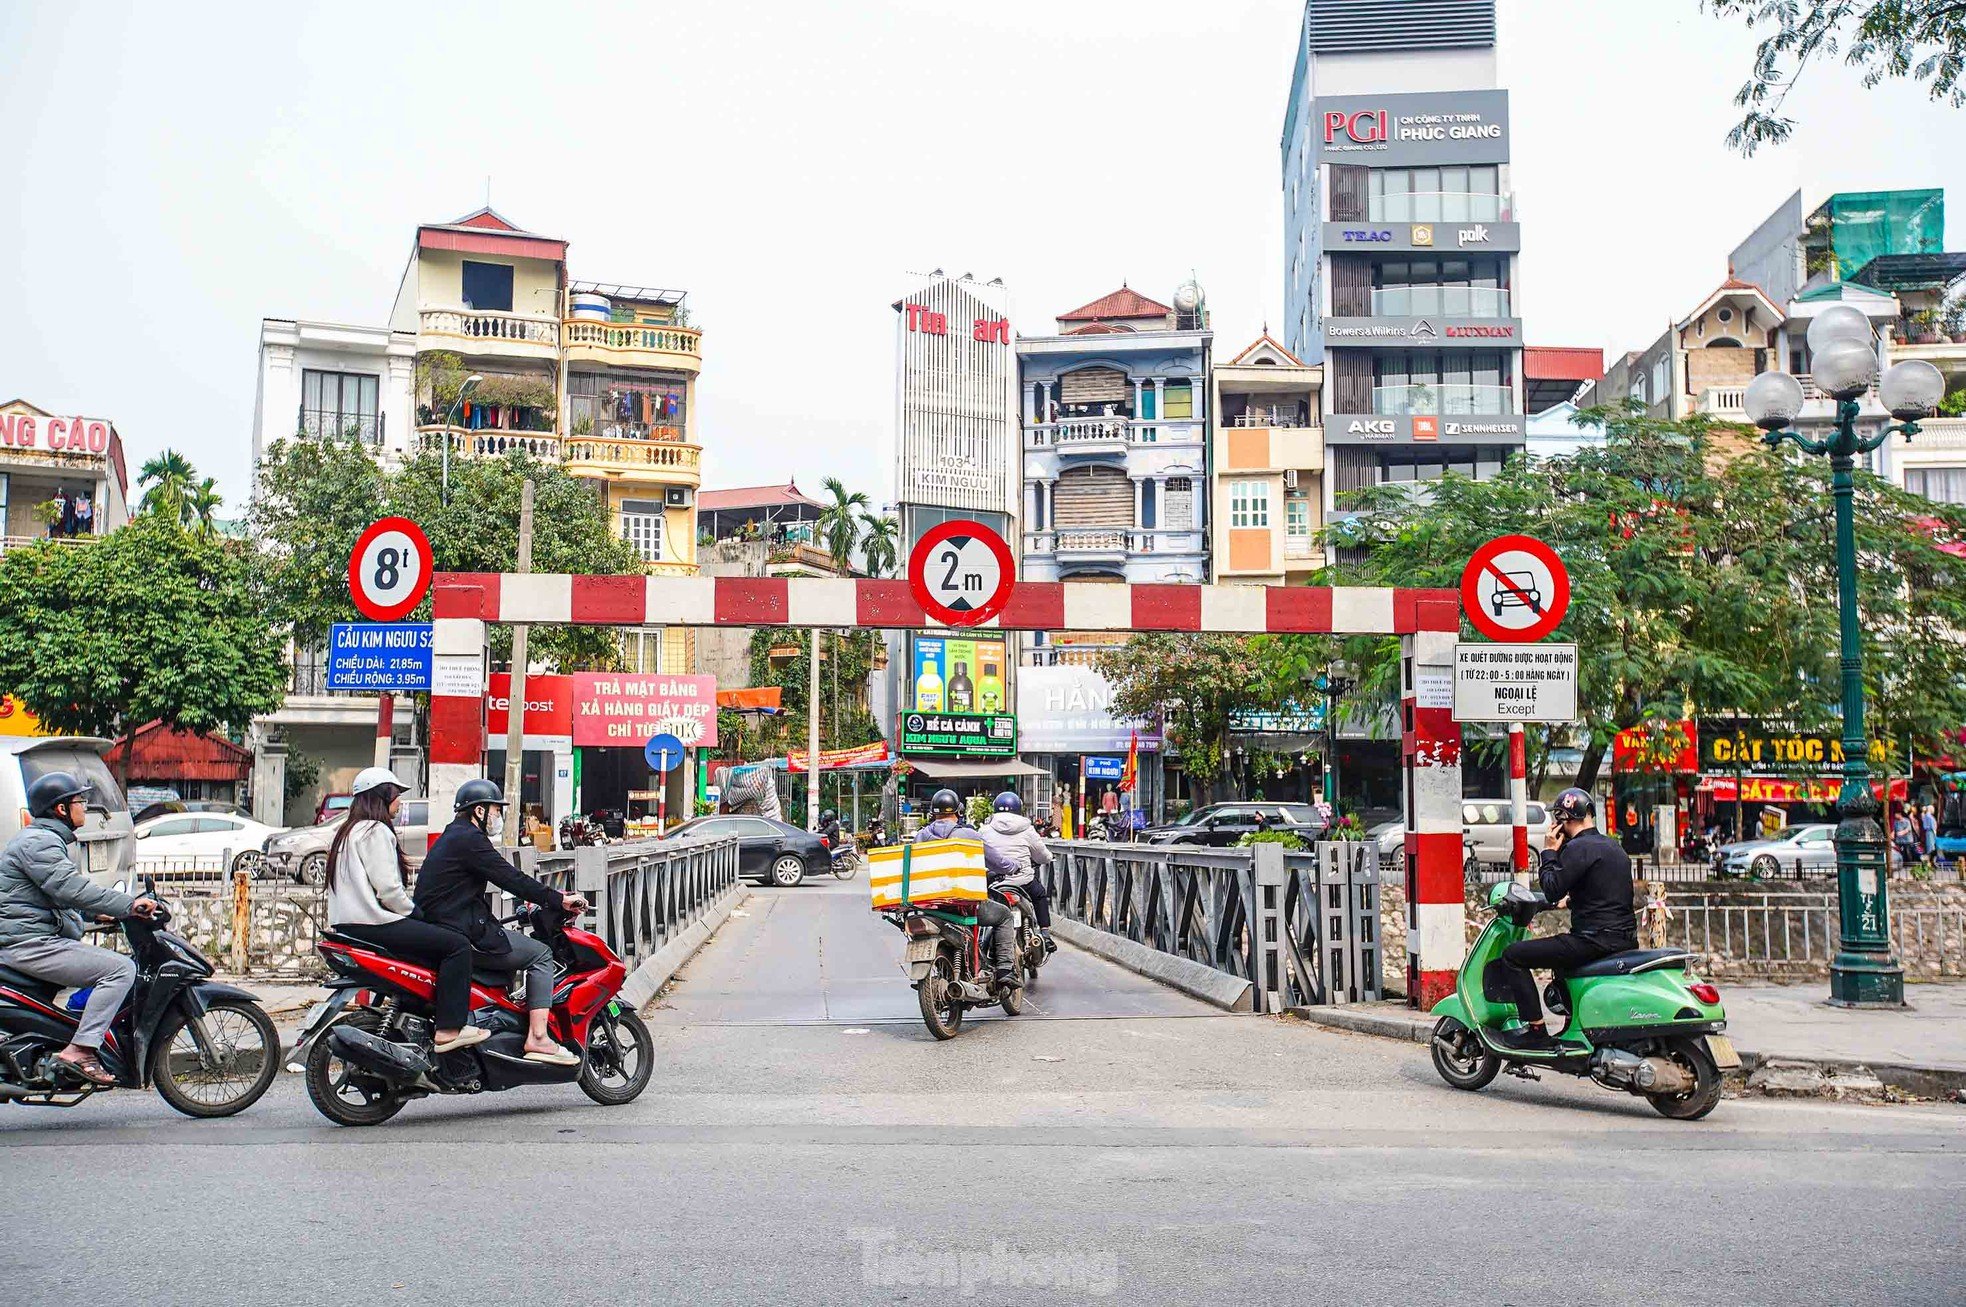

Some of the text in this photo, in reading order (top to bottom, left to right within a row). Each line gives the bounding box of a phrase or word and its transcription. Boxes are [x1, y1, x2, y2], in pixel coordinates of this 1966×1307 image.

[1323, 109, 1389, 143] PGI
[1401, 116, 1414, 125] CN
[1454, 114, 1481, 122] TNHH
[1400, 124, 1501, 140] PHÚC GIANG
[1343, 231, 1393, 242] TEAC
[1458, 224, 1489, 247] polk
[905, 303, 1010, 346] Tin art
[1348, 420, 1396, 433] AKG
[1462, 425, 1518, 434] SENNHEISER
[48, 416, 107, 453] CÁO
[921, 474, 947, 485] KIM
[337, 625, 360, 648] CẦU
[361, 631, 383, 648] KIM
[385, 630, 417, 648] NGƯU
[335, 654, 364, 669] CHIỀU
[366, 655, 385, 669] DÀI:
[1459, 651, 1573, 665] XE QUÉT ĐƯỜNG ĐƯỢC HOẠT ĐỘNG
[334, 670, 362, 684] CHIỀU
[365, 671, 395, 686] RỘNG:
[1526, 669, 1544, 680] HÀNG
[594, 678, 698, 698] TRẢ MẶT BẰNG
[1494, 685, 1537, 702] NGOẠI LỆ
[581, 698, 601, 715] XẢ
[604, 700, 644, 716] HÀNG
[683, 702, 711, 717] DÉP
[1498, 703, 1535, 716] Except
[607, 720, 632, 737] CHỈ
[940, 718, 953, 731] CÁ
[905, 733, 927, 743] KIM
[1771, 733, 1823, 762] TÓC
[1088, 767, 1101, 775] KIM
[1862, 917, 1877, 931] 21
